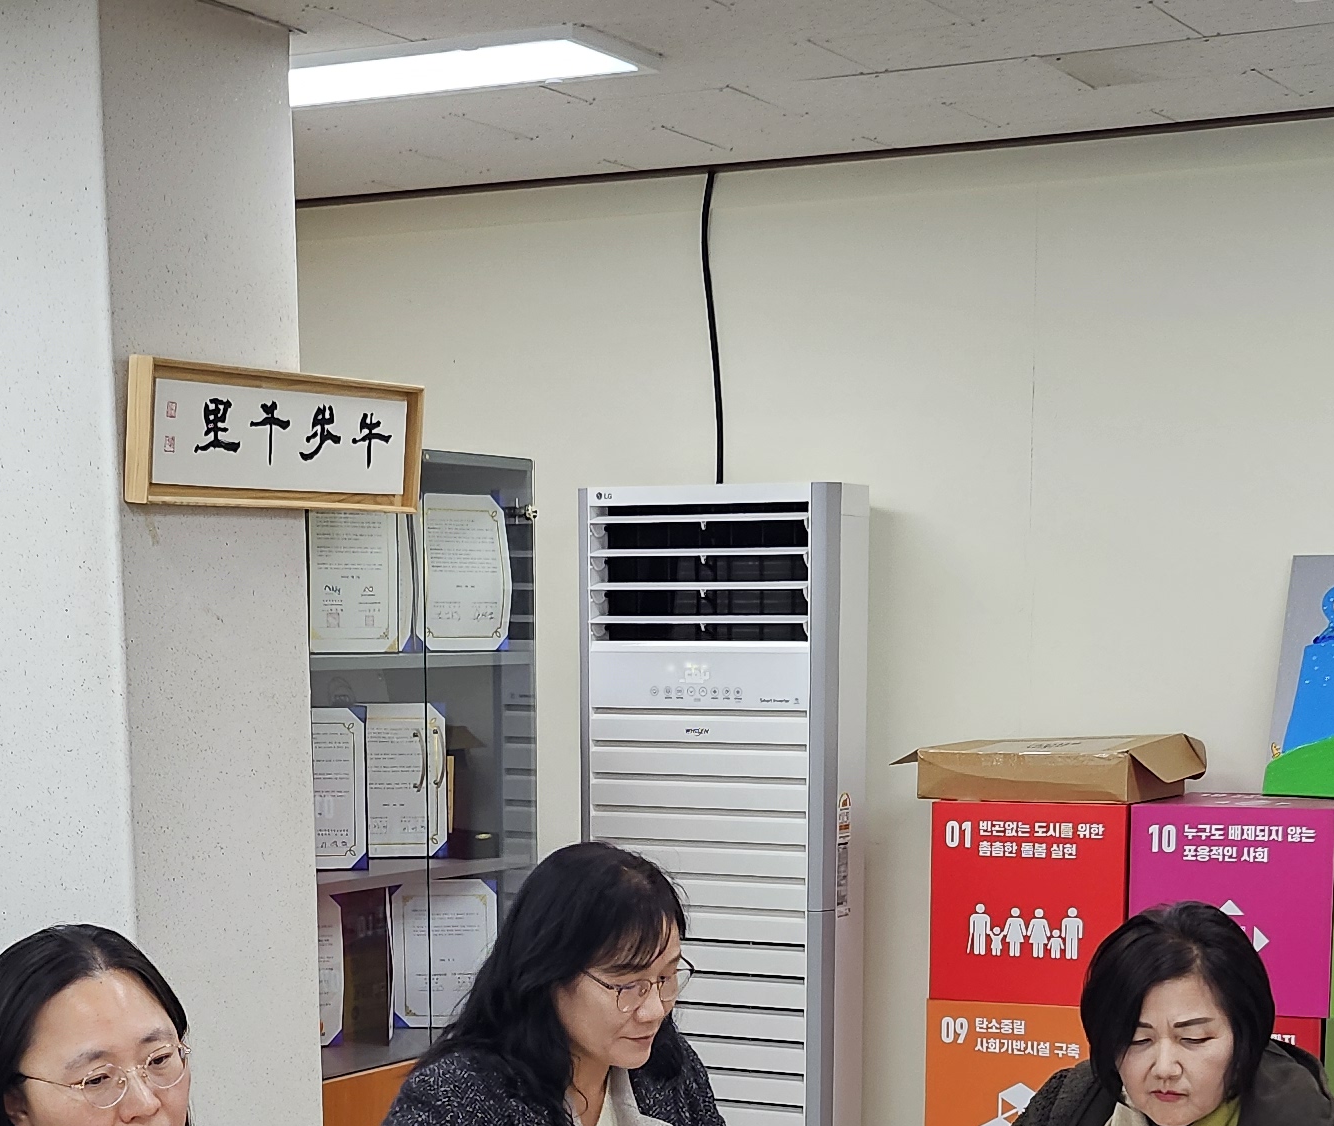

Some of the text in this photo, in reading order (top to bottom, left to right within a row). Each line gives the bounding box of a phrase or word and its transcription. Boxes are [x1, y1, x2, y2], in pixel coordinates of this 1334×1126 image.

[945, 820, 972, 848] 01
[979, 820, 1105, 839] 빈곤없는 도시를 위한
[1148, 824, 1176, 853] 10
[1183, 824, 1316, 842] 누구도 배제되지 않는
[979, 841, 1077, 859] 촘촘한 돌봄 실현
[1183, 845, 1269, 863] 포용적인 사회
[940, 1016, 968, 1043] 09
[975, 1017, 1025, 1035] 탄소중립
[974, 1038, 1080, 1059] 사회기반시설 구축
